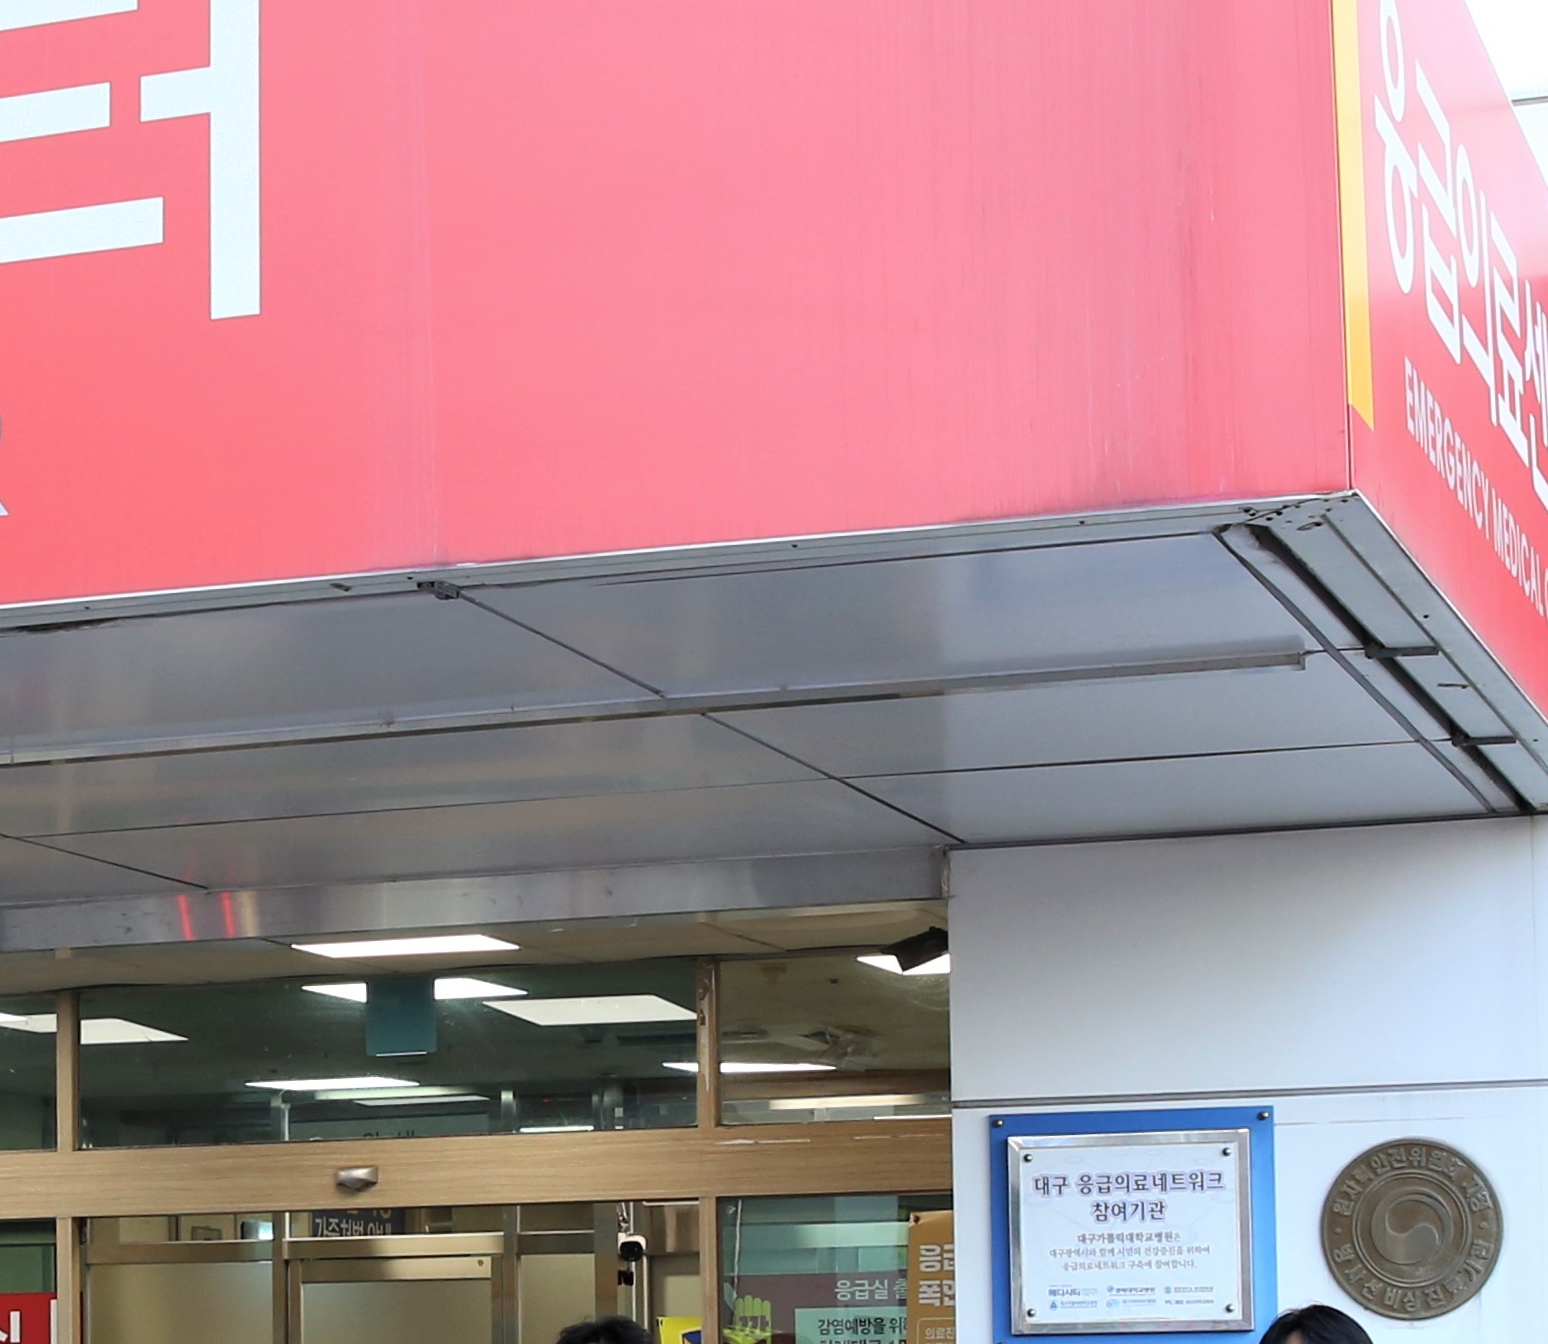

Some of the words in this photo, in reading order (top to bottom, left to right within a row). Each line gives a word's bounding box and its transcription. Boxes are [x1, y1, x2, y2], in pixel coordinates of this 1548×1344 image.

[1404, 356, 1490, 540] EMERGENCY
[1492, 487, 1544, 617] MEDICAL
[1034, 1175, 1069, 1196] 대구
[1077, 1171, 1225, 1195] 응급의료네트워크
[1093, 1200, 1166, 1222] 참여기관
[835, 1279, 889, 1301] 응급실
[817, 1317, 887, 1336] 감염예방을
